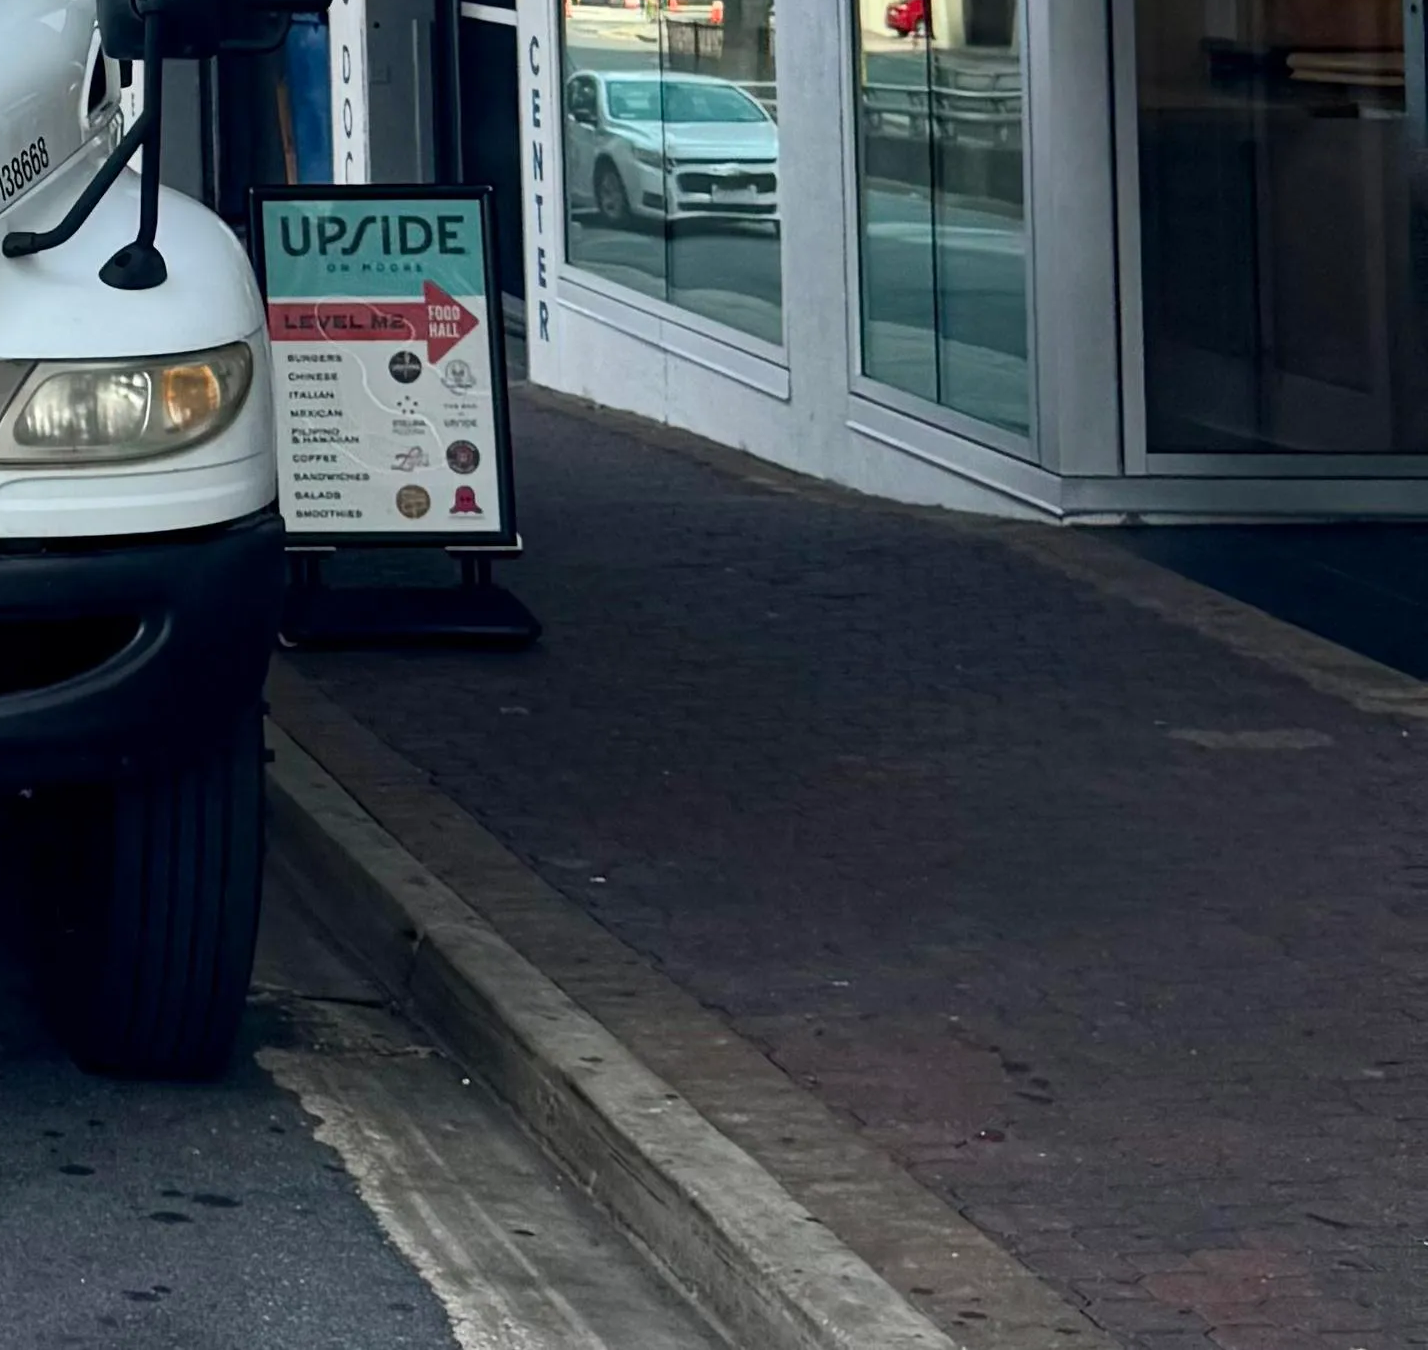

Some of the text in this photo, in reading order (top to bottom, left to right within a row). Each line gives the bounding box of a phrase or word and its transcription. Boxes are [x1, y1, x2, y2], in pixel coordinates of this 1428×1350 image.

[342, 44, 354, 185] DOC
[528, 35, 550, 343] CENTER
[280, 215, 466, 257] UPSIDE
[427, 304, 461, 321] FOOD
[284, 314, 362, 331] LEVEL
[428, 320, 461, 338] HALL
[288, 391, 335, 399] ITALIAN
[290, 409, 343, 417] MEXICAN
[292, 454, 338, 463] COFFEE
[293, 473, 370, 481] SANDWICHES
[294, 491, 342, 500] SALADS
[295, 509, 363, 518] SMOOTHIES
